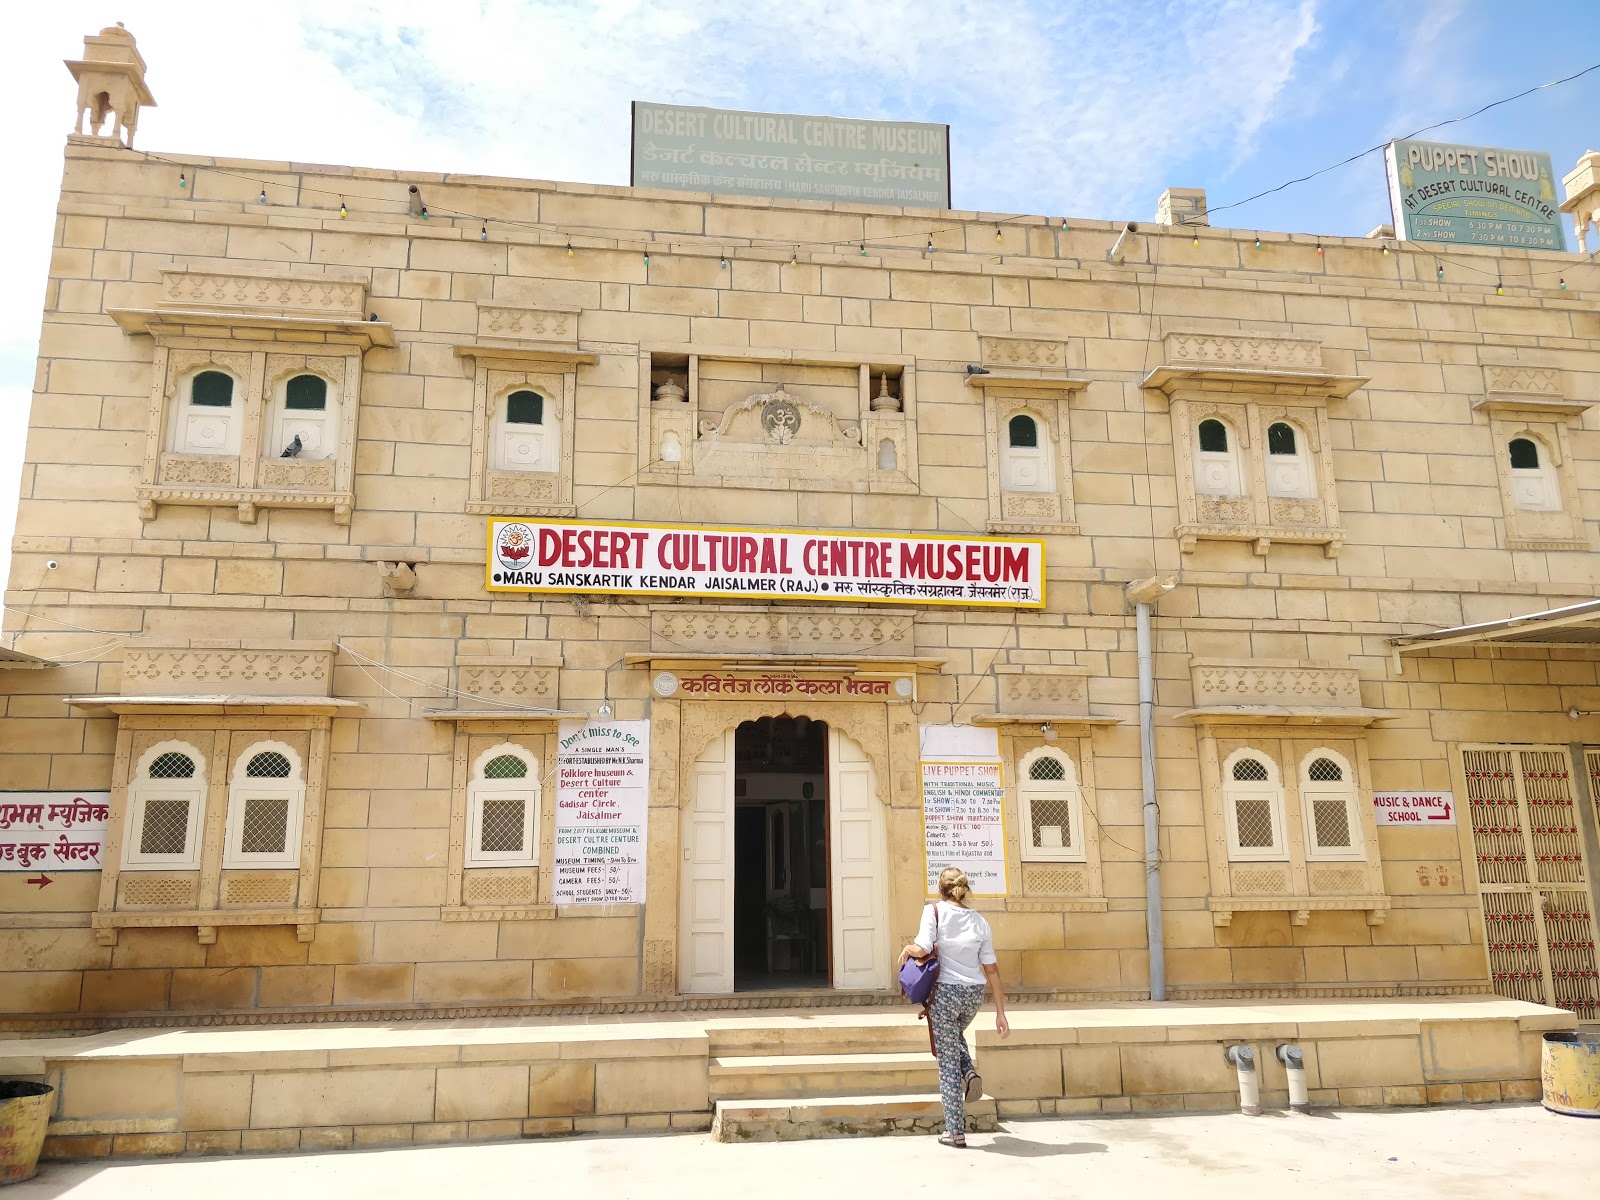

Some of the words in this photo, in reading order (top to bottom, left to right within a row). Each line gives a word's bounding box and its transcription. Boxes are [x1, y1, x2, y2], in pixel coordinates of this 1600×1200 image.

[642, 109, 708, 137] DESERT
[714, 114, 798, 144] CULTURAL
[804, 121, 866, 150] CENTRE
[873, 126, 942, 154] MUSEUM
[700, 151, 789, 170] कल्चरल
[854, 158, 942, 183] म्यूजियम
[1408, 144, 1478, 176] PUPPET
[1484, 152, 1540, 180] SHOW
[863, 187, 895, 199] KENDRA
[1405, 194, 1418, 210] AT
[1417, 180, 1456, 200] DESERT
[1460, 180, 1511, 198] CULTURAL
[1515, 190, 1556, 220] CENTRE
[1433, 200, 1460, 213] SPECIAL
[1500, 203, 1532, 219] DEMAND
[1464, 210, 1499, 218] TIMINGS
[1469, 221, 1486, 230] 6:30
[1507, 224, 1517, 232] TO
[1519, 225, 1535, 233] 7:30
[1433, 230, 1456, 238] SHOW
[1471, 233, 1488, 241] 7:30
[538, 528, 649, 569] DESERT
[657, 534, 792, 574] CULTURAL
[803, 539, 892, 578] CENTRE
[900, 543, 1029, 583] MUSEUM
[504, 572, 542, 586] MARU
[548, 573, 632, 588] SANSKARTIK
[640, 575, 696, 589] KENDAR
[705, 577, 776, 592] JAISALMER
[780, 580, 819, 594] (RAJ.)
[833, 582, 853, 594] मरु
[857, 580, 916, 597] सांस्कृतिक
[968, 582, 1007, 600] जैसलमेर
[681, 674, 721, 696] कवि
[723, 674, 751, 694] तेज
[753, 674, 794, 695] लोक
[796, 678, 843, 696] कला
[843, 676, 891, 696] भवन
[589, 727, 611, 737] miss
[612, 729, 622, 738] to
[561, 769, 592, 778] Folklore
[924, 766, 941, 775] LIVE
[944, 766, 975, 775] PUPPET
[978, 766, 998, 775] SHOW
[561, 779, 588, 788] Desert
[560, 800, 588, 808] Gadisar
[1373, 797, 1400, 807] MUSIC
[1403, 797, 1409, 808] &
[1412, 797, 1442, 807] DANCE
[577, 810, 622, 820] Jaisalmer
[1388, 812, 1421, 821] SCHOOL
[54, 834, 101, 864] सेन्टर
